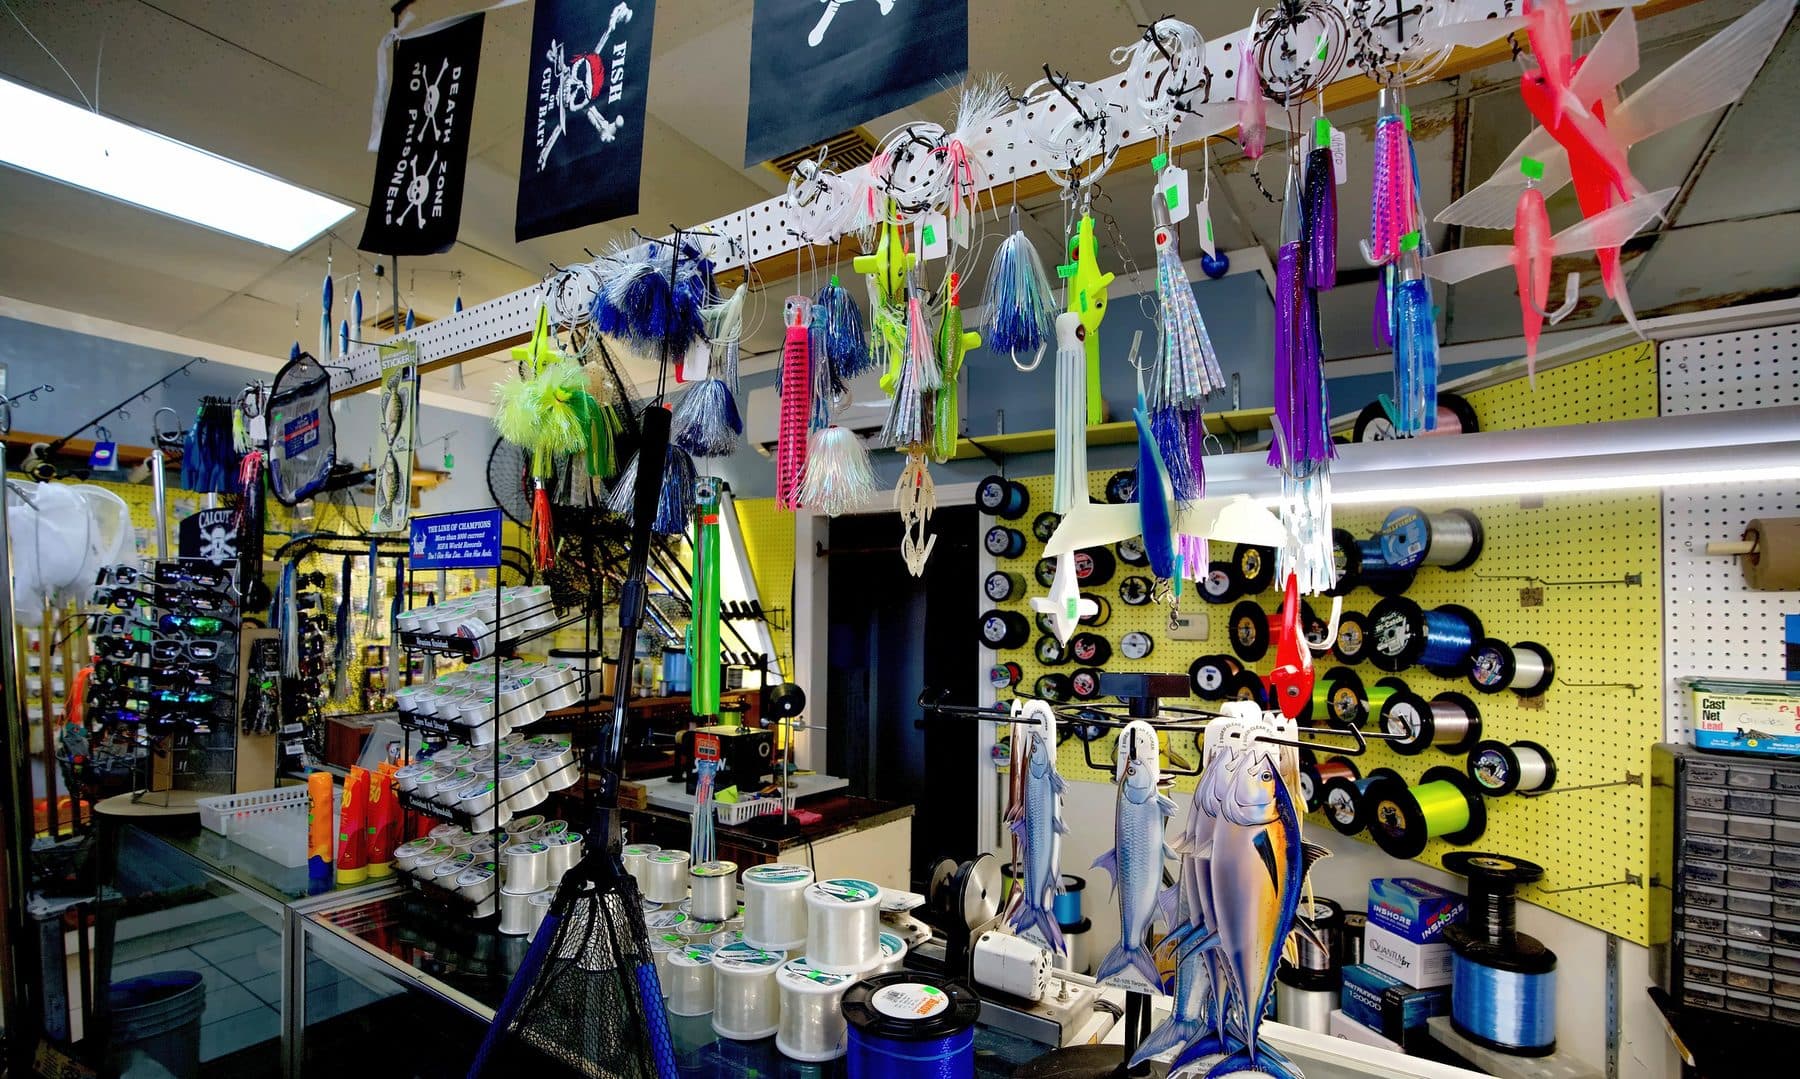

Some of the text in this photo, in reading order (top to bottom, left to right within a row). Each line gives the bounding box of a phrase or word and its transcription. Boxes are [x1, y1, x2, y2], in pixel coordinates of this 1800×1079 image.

[607, 40, 628, 104] FISH
[536, 67, 552, 147] CUT BAIT
[431, 66, 462, 217] DEATH ZONE
[385, 108, 418, 225] PRISONERS
[427, 520, 492, 534] THE LINE OF CHAMPIONS
[449, 541, 463, 549] World
[1702, 698, 1726, 710] Cast
[1702, 710, 1721, 721] Net
[1702, 721, 1724, 731] Lead
[1373, 904, 1412, 926] INSHORE
[1421, 903, 1465, 940] INSHORE
[1369, 938, 1402, 962] QUANTUM
